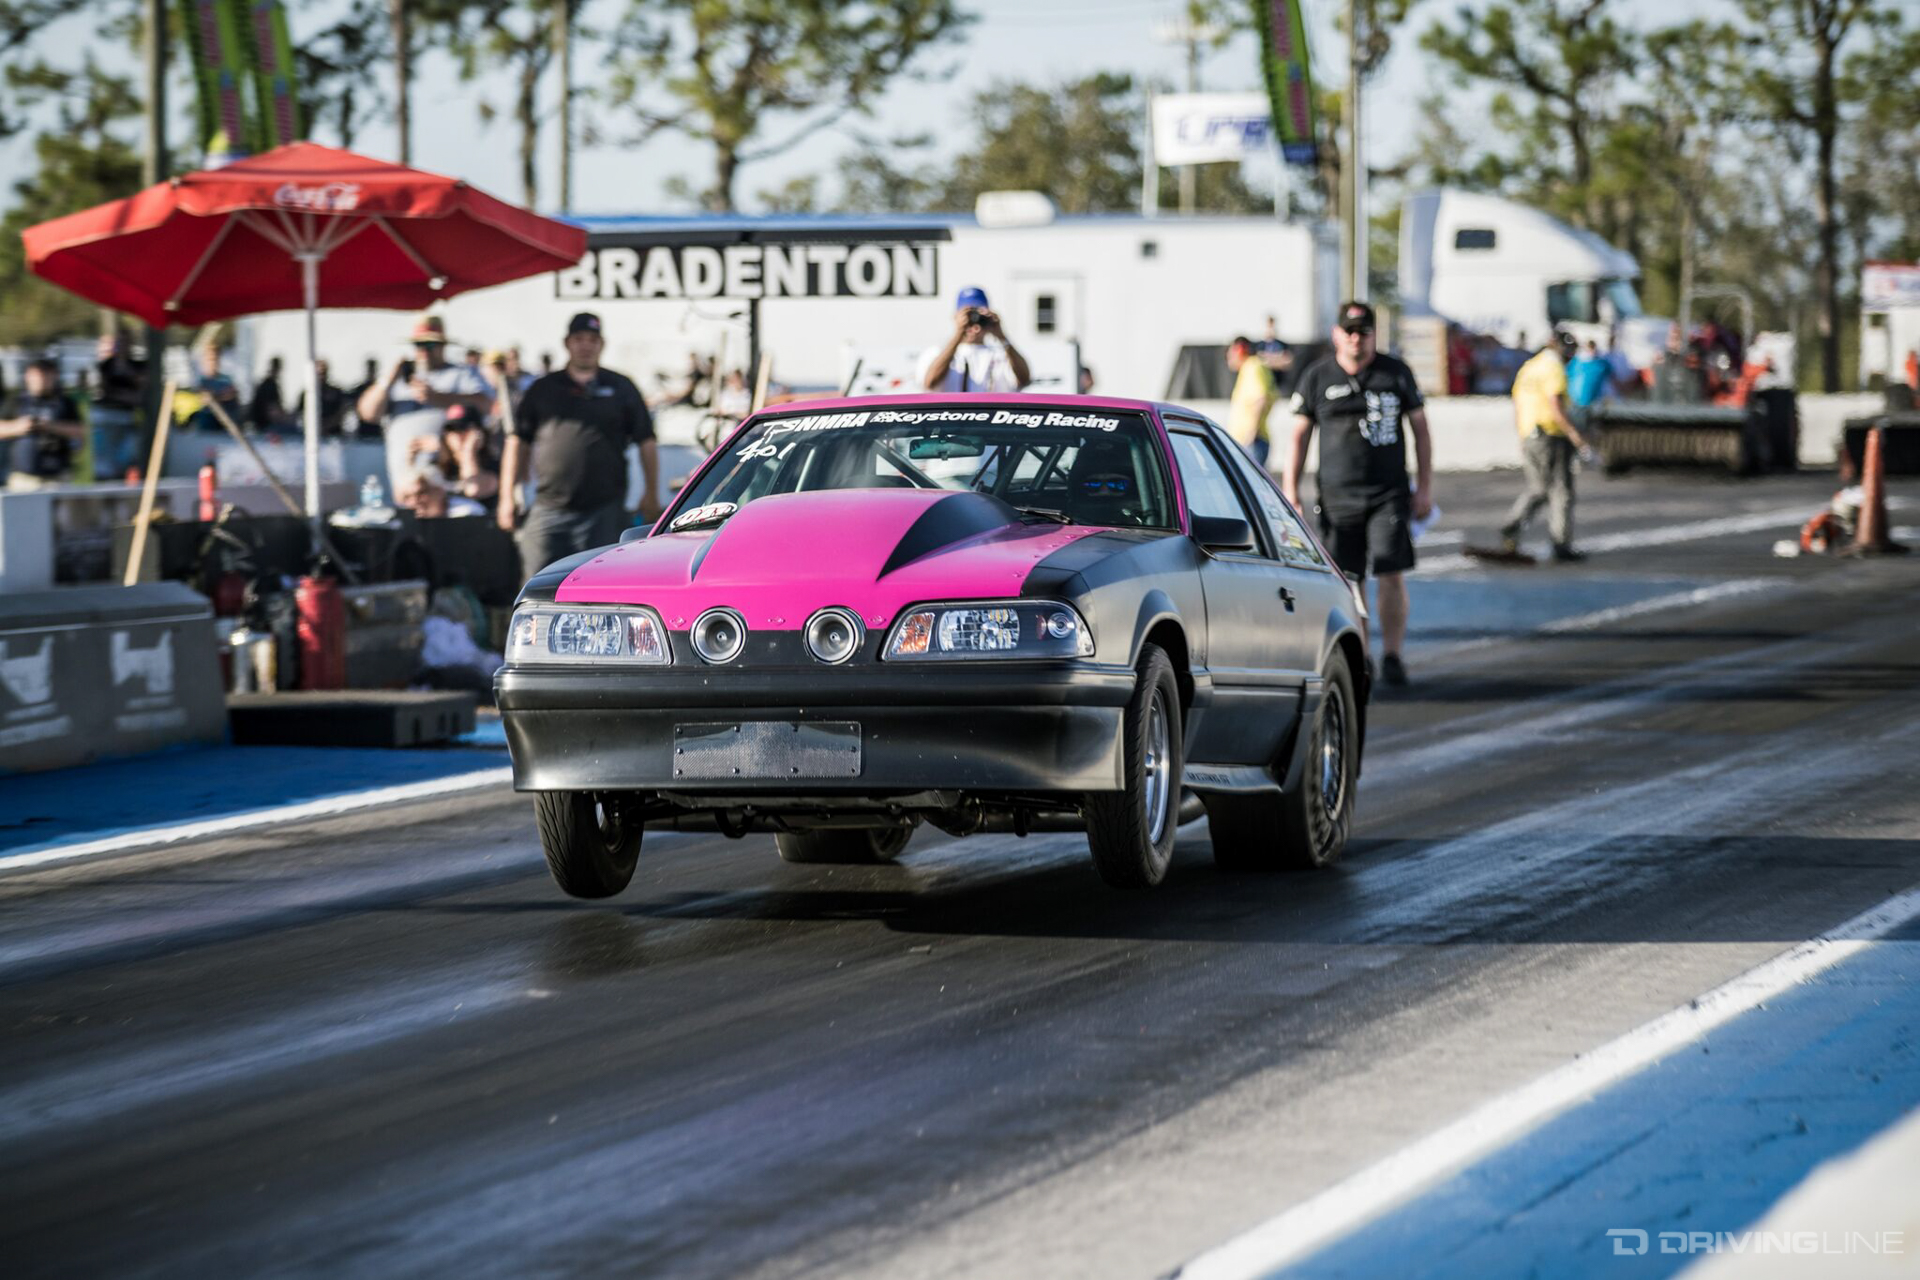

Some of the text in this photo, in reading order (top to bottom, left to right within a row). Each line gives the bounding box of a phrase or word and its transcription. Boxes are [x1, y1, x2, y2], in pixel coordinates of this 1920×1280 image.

[558, 243, 938, 299] BRADENTON
[794, 410, 1120, 432] NMRA Keystone Drag Racing
